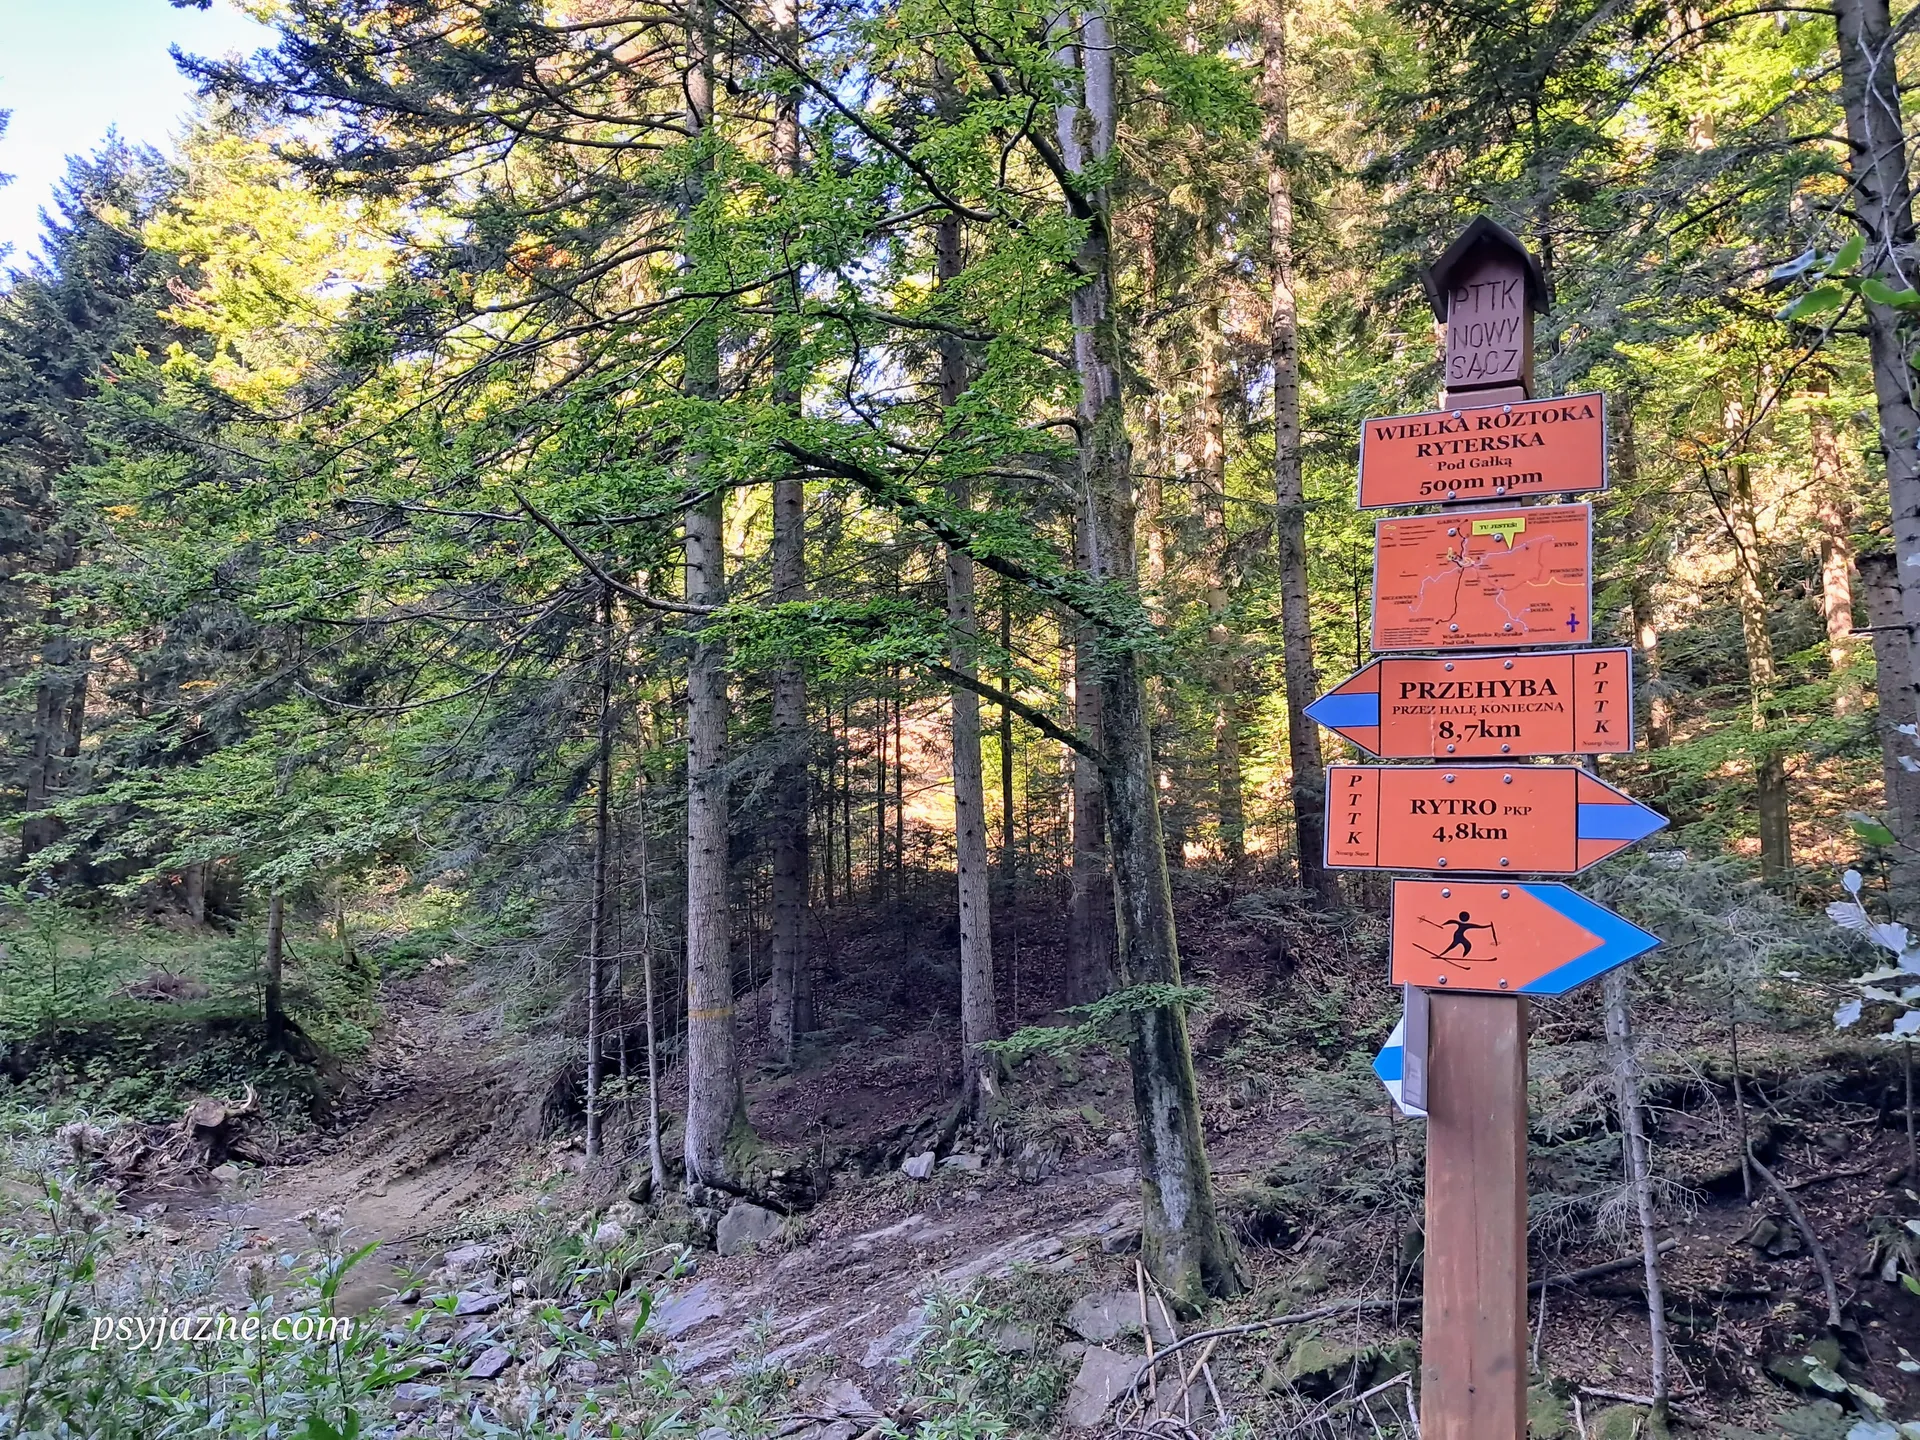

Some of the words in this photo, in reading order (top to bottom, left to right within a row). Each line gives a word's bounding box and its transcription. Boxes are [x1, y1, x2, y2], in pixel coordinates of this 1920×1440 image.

[1452, 279, 1518, 315] PTTK
[1453, 317, 1519, 350] NOWY
[1451, 349, 1518, 379] SĄCZ
[1374, 417, 1470, 441] WIELKA
[1416, 431, 1545, 458] RYTERSKA
[1437, 459, 1465, 471] Pod
[1469, 456, 1513, 469] Gałką
[1419, 477, 1485, 496] 500m
[1492, 471, 1543, 490] npm
[1399, 678, 1558, 699] PRZEHYBA
[1592, 661, 1611, 733] PTTK
[1392, 705, 1436, 715] PRZEZ
[1440, 705, 1476, 716] HALĘ
[1481, 702, 1564, 714] KONIECZNĄ
[1438, 719, 1521, 743] 8,7km
[1346, 775, 1362, 844] PTTK
[1409, 798, 1497, 815] RYTRO
[1503, 806, 1532, 815] PKP
[1432, 822, 1508, 843] 4,8km
